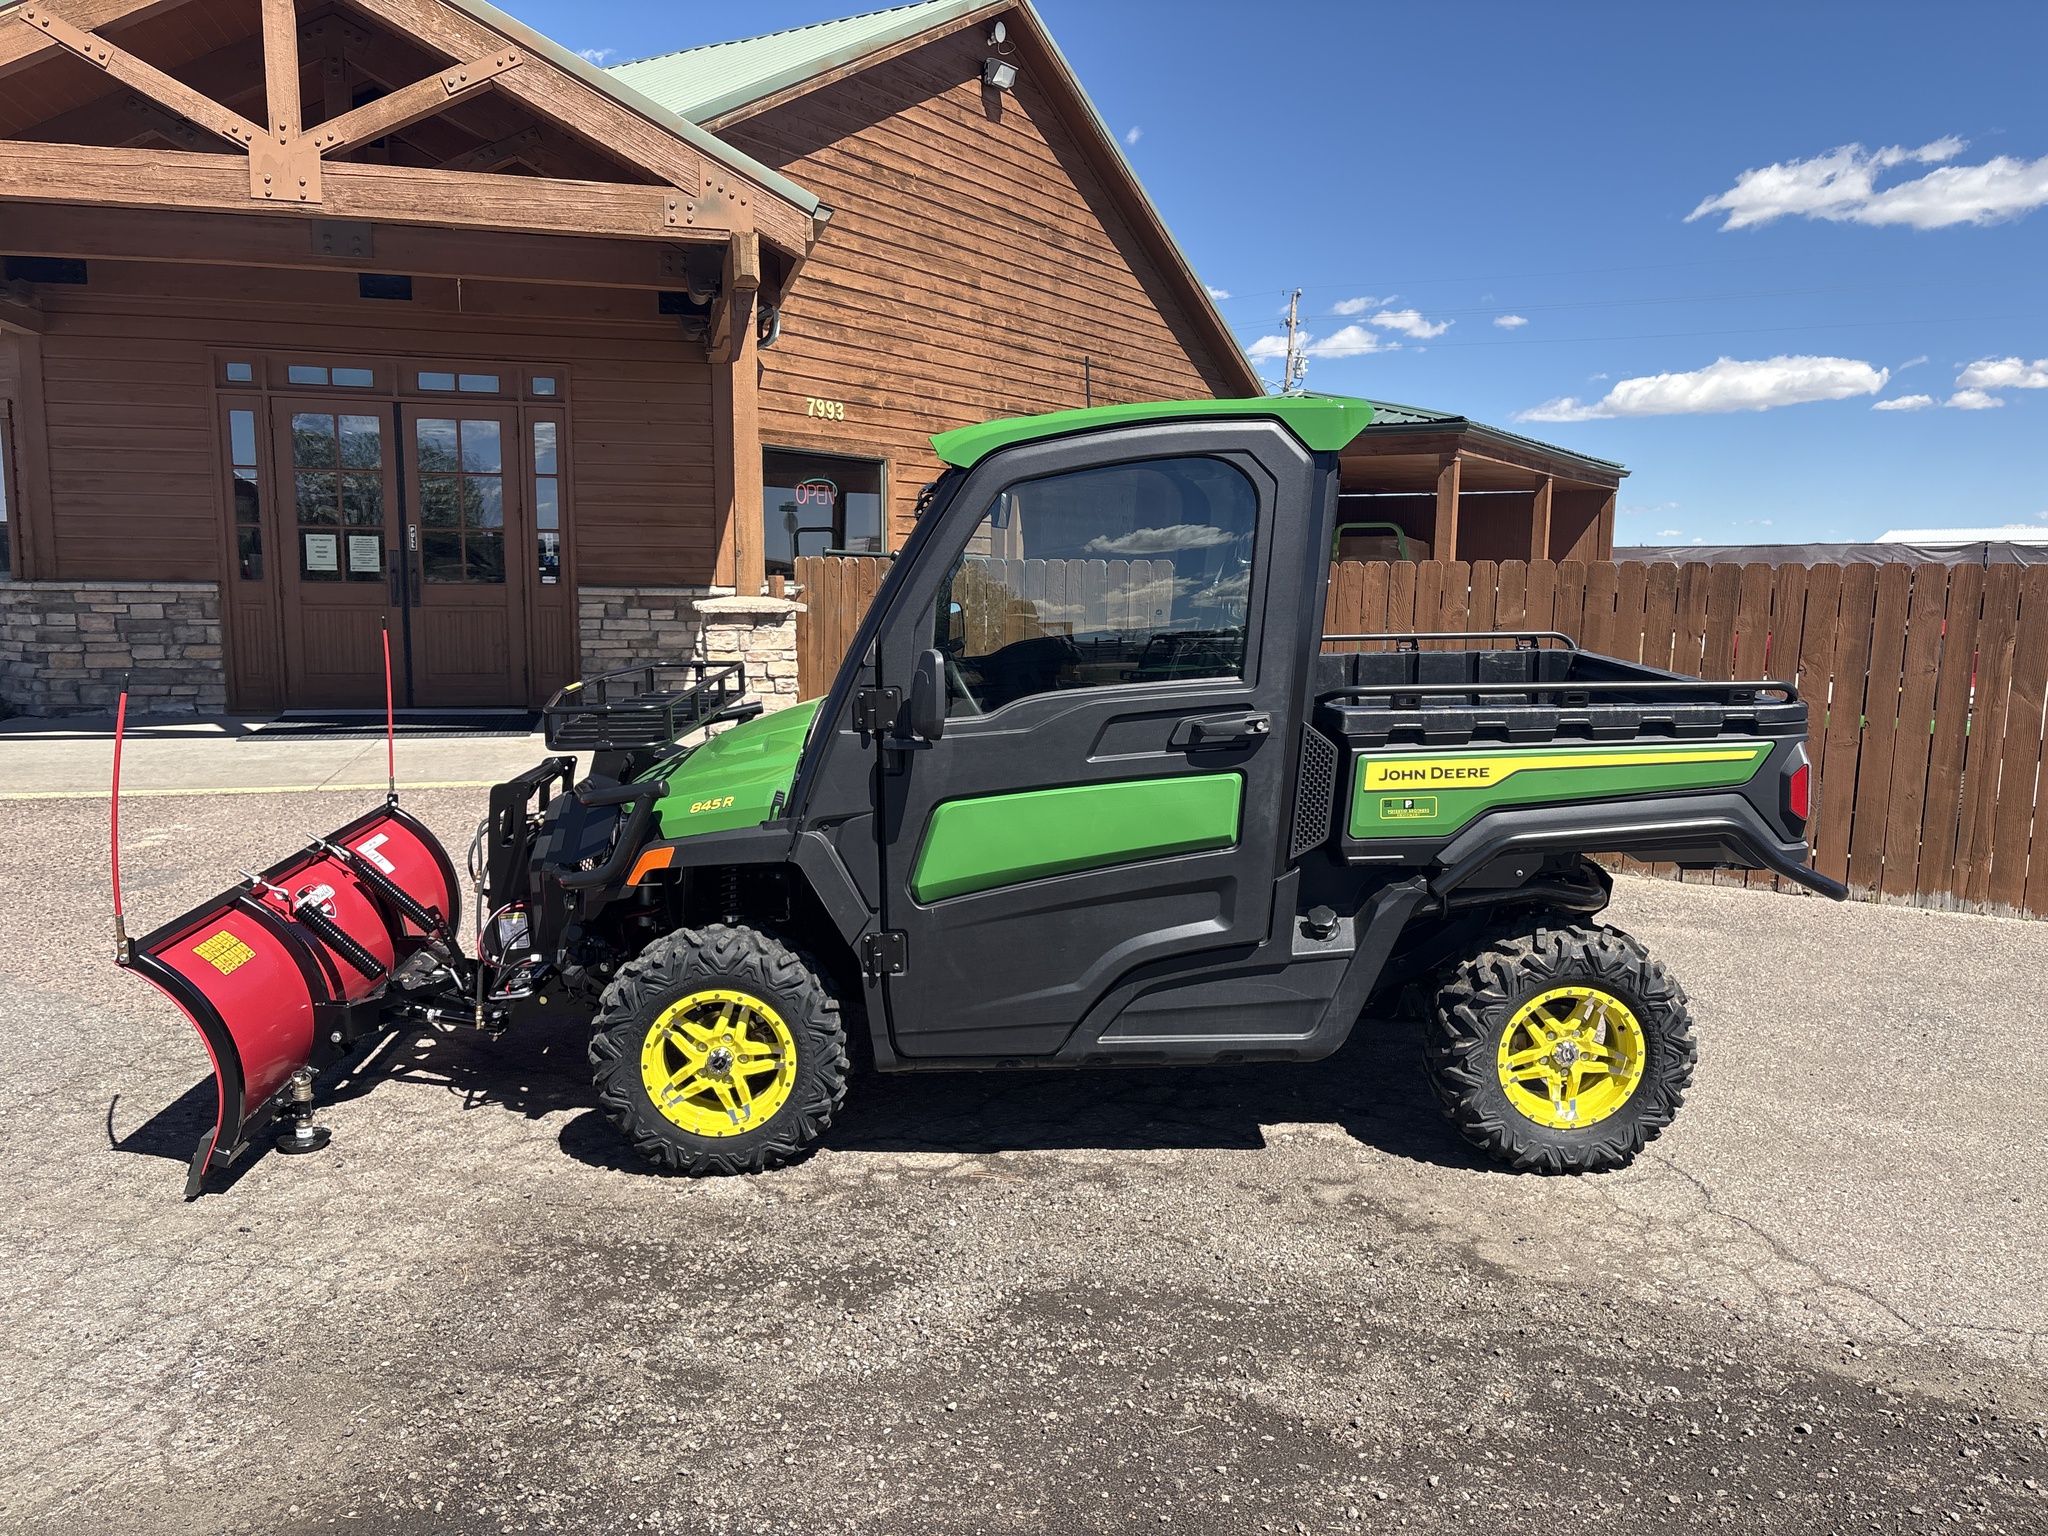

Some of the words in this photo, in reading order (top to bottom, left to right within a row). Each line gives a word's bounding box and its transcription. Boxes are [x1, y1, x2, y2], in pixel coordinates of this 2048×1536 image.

[806, 397, 844, 420] 7993
[795, 484, 835, 505] OPEN
[1379, 768, 1426, 781] JOHN
[1430, 767, 1490, 780] DEERE
